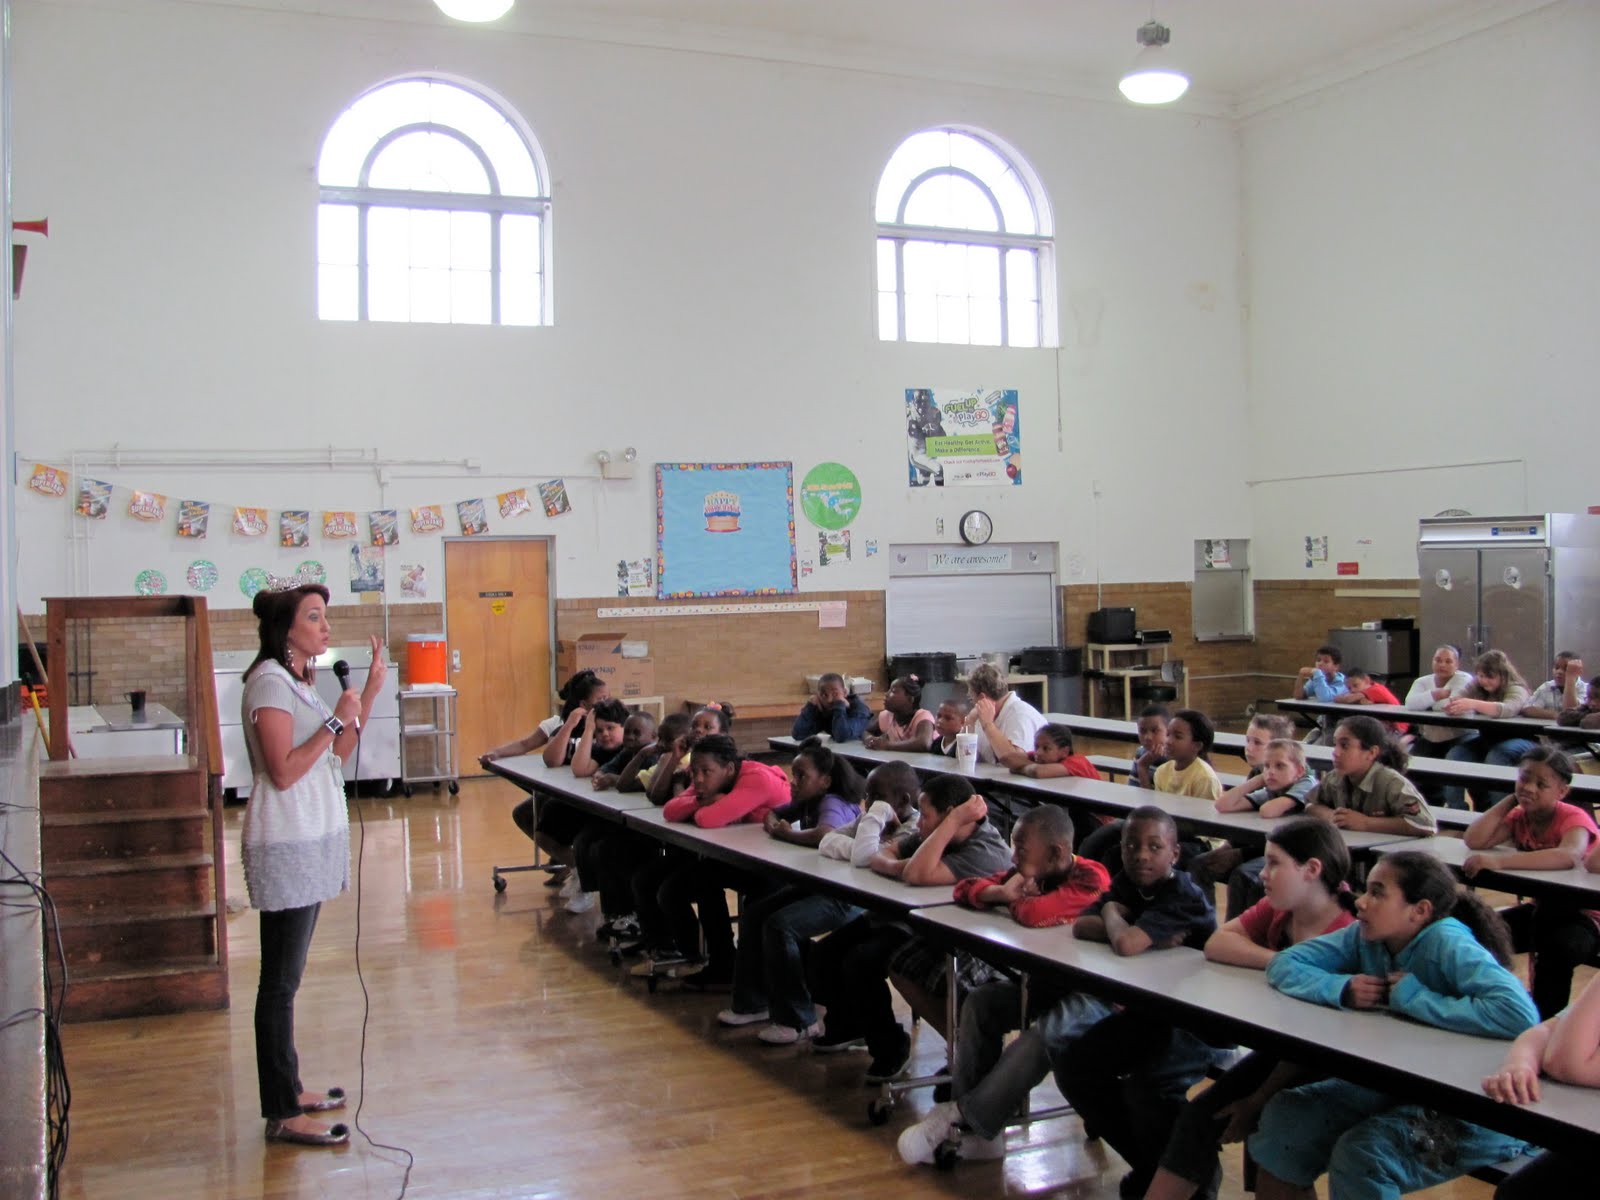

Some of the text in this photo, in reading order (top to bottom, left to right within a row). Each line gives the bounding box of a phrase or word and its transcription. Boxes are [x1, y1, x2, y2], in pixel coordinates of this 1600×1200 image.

[706, 497, 738, 506] HAPPY
[932, 553, 1007, 565] We are awesome!
